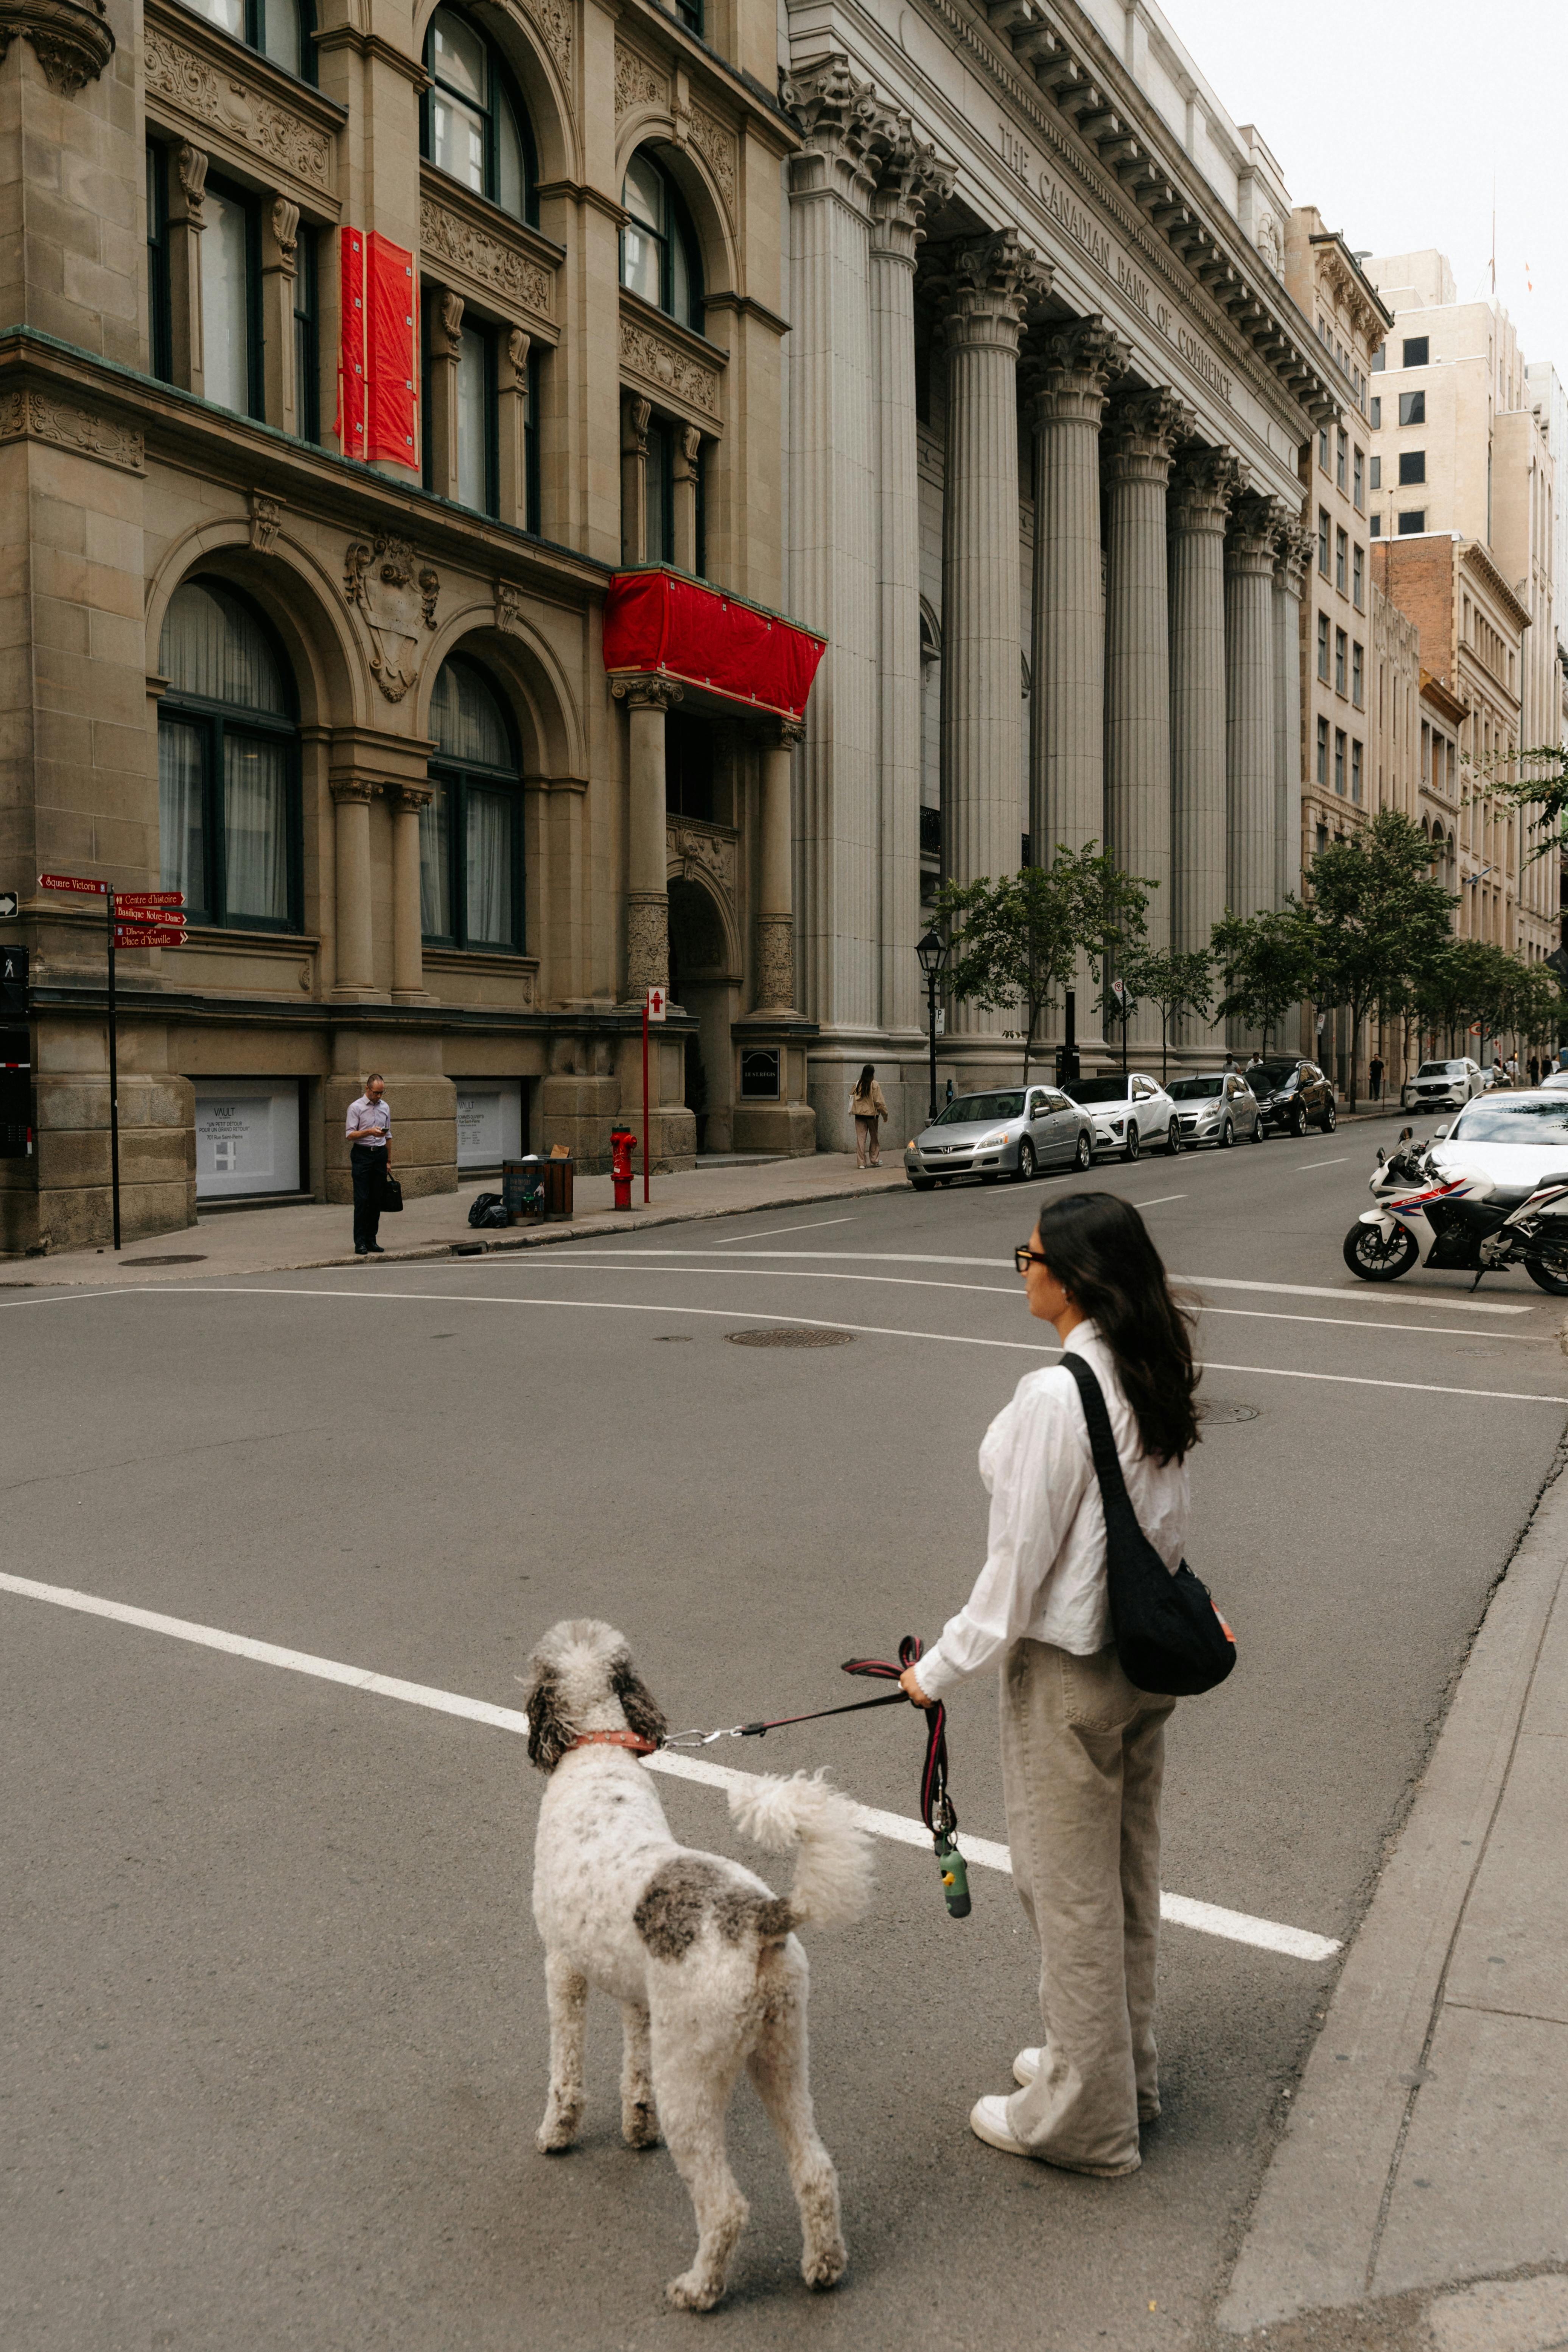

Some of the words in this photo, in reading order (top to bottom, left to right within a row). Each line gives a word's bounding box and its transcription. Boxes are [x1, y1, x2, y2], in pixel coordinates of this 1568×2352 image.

[999, 123, 1029, 182] THE
[1039, 172, 1109, 271] CANADIAN
[1118, 257, 1149, 314] BANK
[1157, 303, 1172, 335] OF
[1178, 327, 1232, 405] COMMERCE
[46, 877, 70, 890] Square
[72, 879, 96, 891] Victoria
[125, 895, 146, 904] Centre
[148, 894, 177, 904] d'histoire
[118, 907, 144, 920] Basilique
[146, 910, 181, 923] Notre-Dame
[122, 936, 139, 946] Place
[141, 935, 171, 945] d'Youville
[938, 1010, 942, 1019] P
[214, 1108, 235, 1116] VAULT
